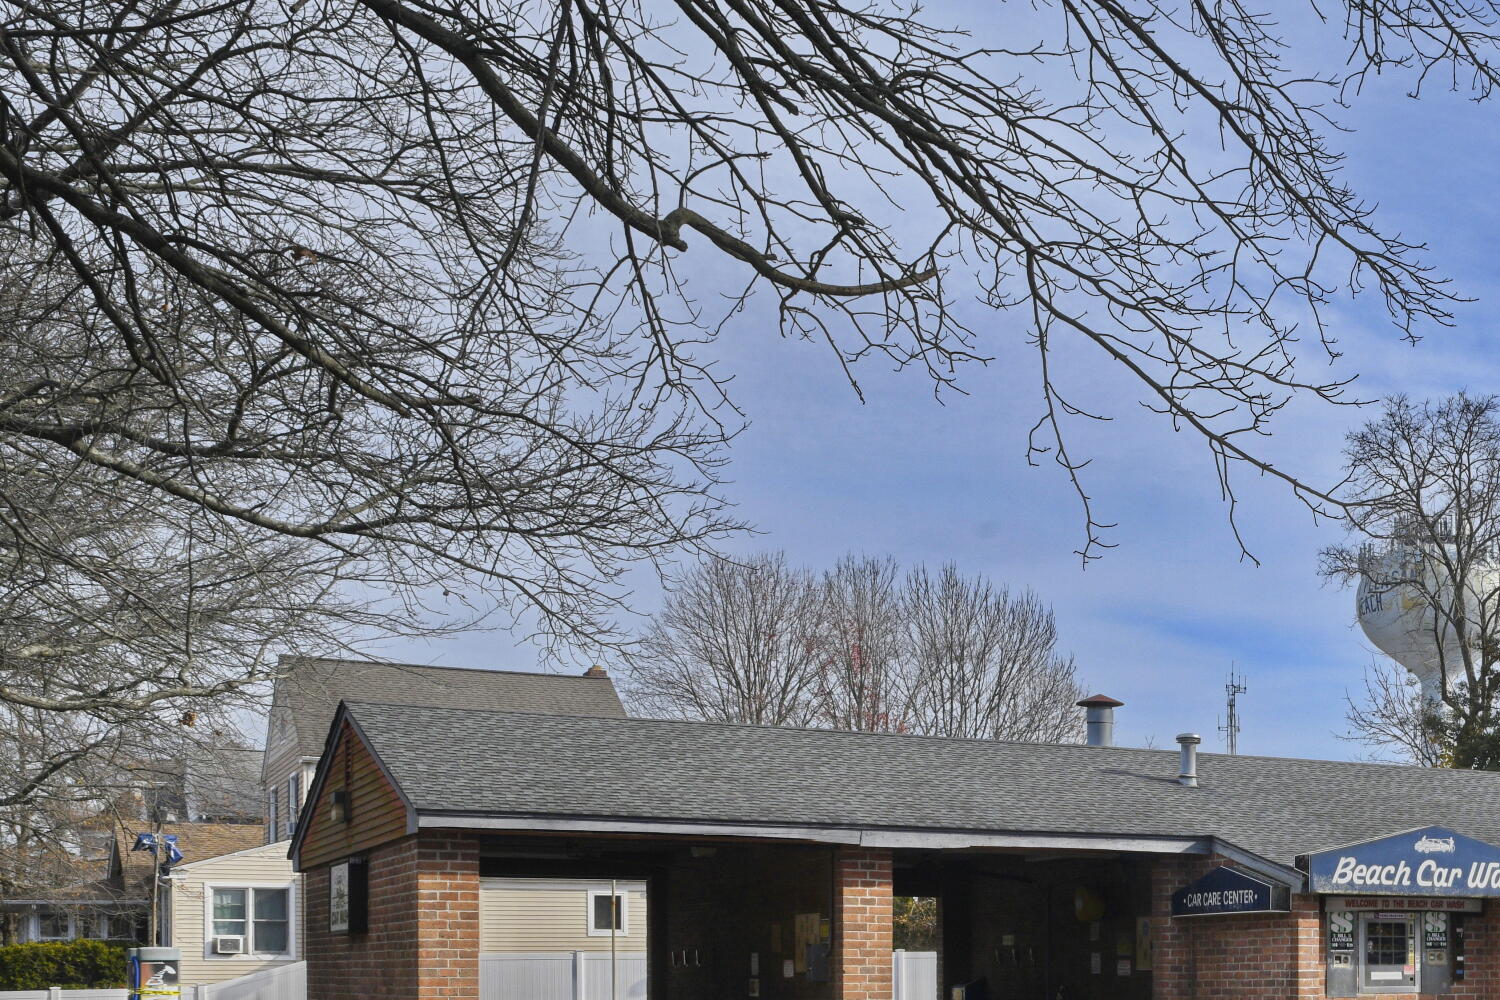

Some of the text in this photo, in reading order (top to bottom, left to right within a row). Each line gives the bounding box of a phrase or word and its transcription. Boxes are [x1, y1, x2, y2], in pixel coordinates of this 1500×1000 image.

[1332, 856, 1410, 886] Beach
[1416, 860, 1462, 887] Car
[1187, 890, 1254, 907] CAR CARE CENTER
[1345, 900, 1465, 909] WELCOME TO THE BEACH CAR WASH
